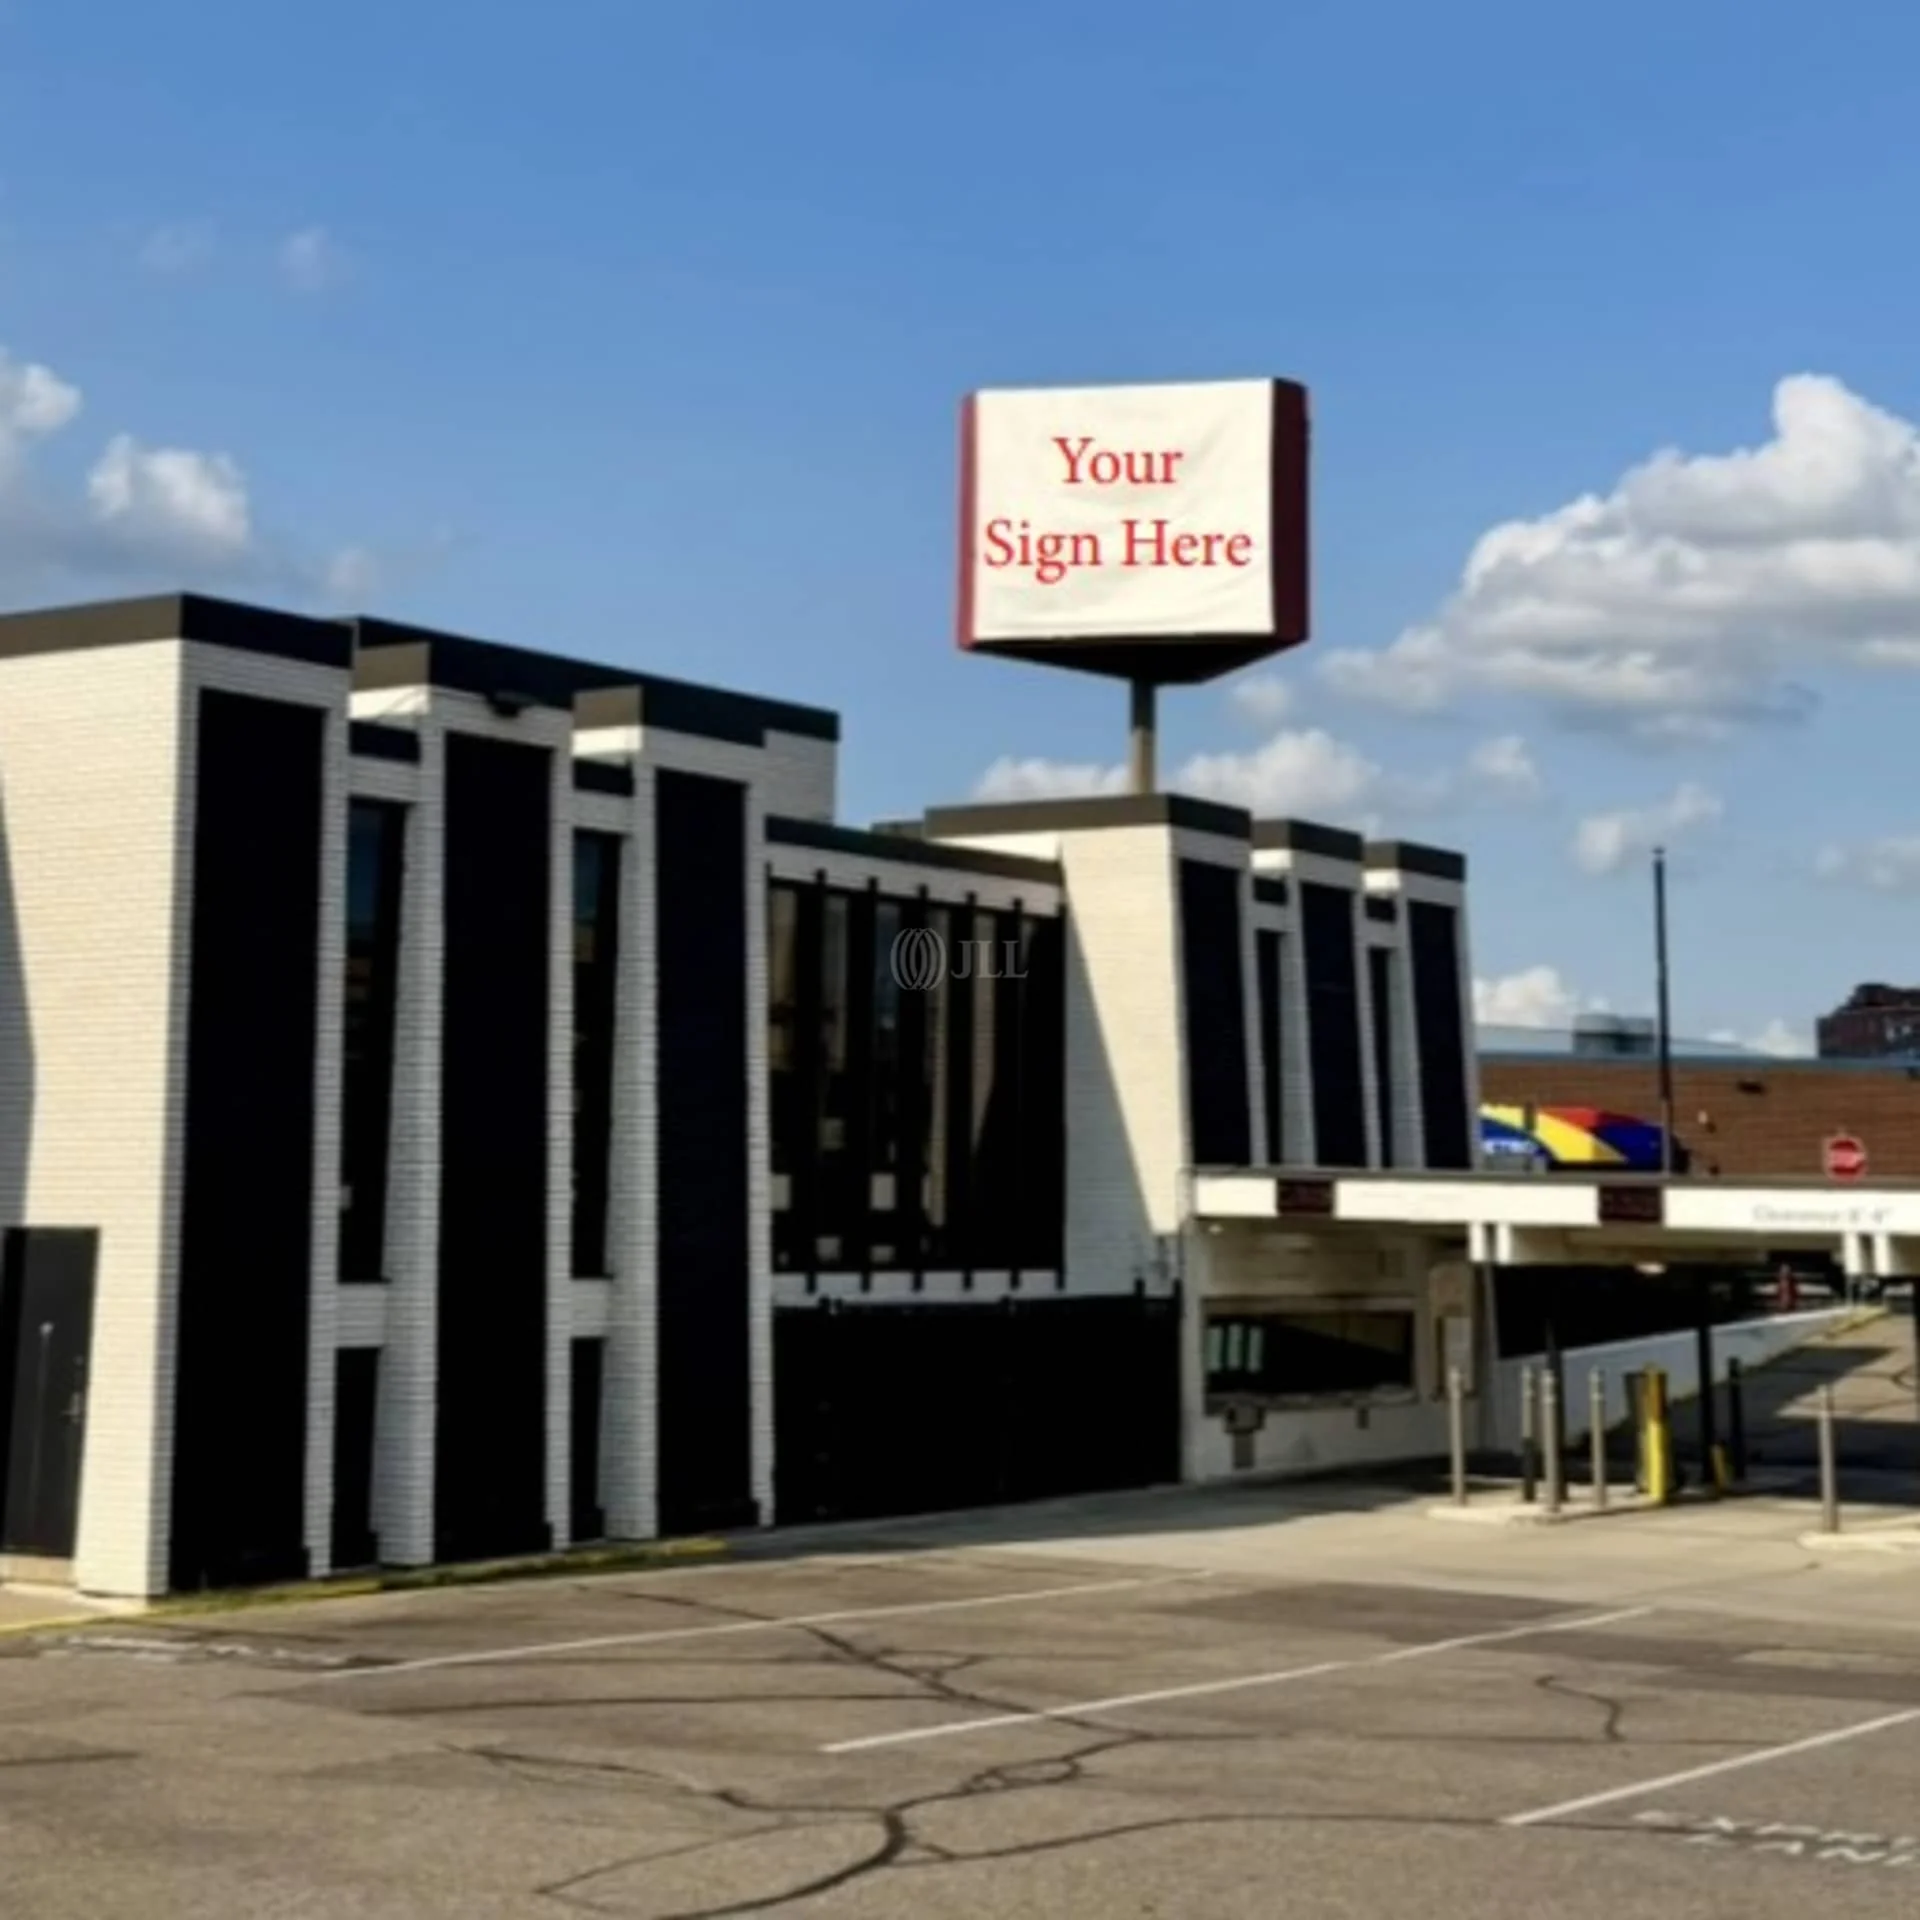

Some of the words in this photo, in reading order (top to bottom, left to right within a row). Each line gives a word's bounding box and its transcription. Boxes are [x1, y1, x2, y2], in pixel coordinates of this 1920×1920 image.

[1052, 436, 1184, 484] Your
[983, 518, 1103, 585] Sign
[1120, 518, 1253, 567] Here
